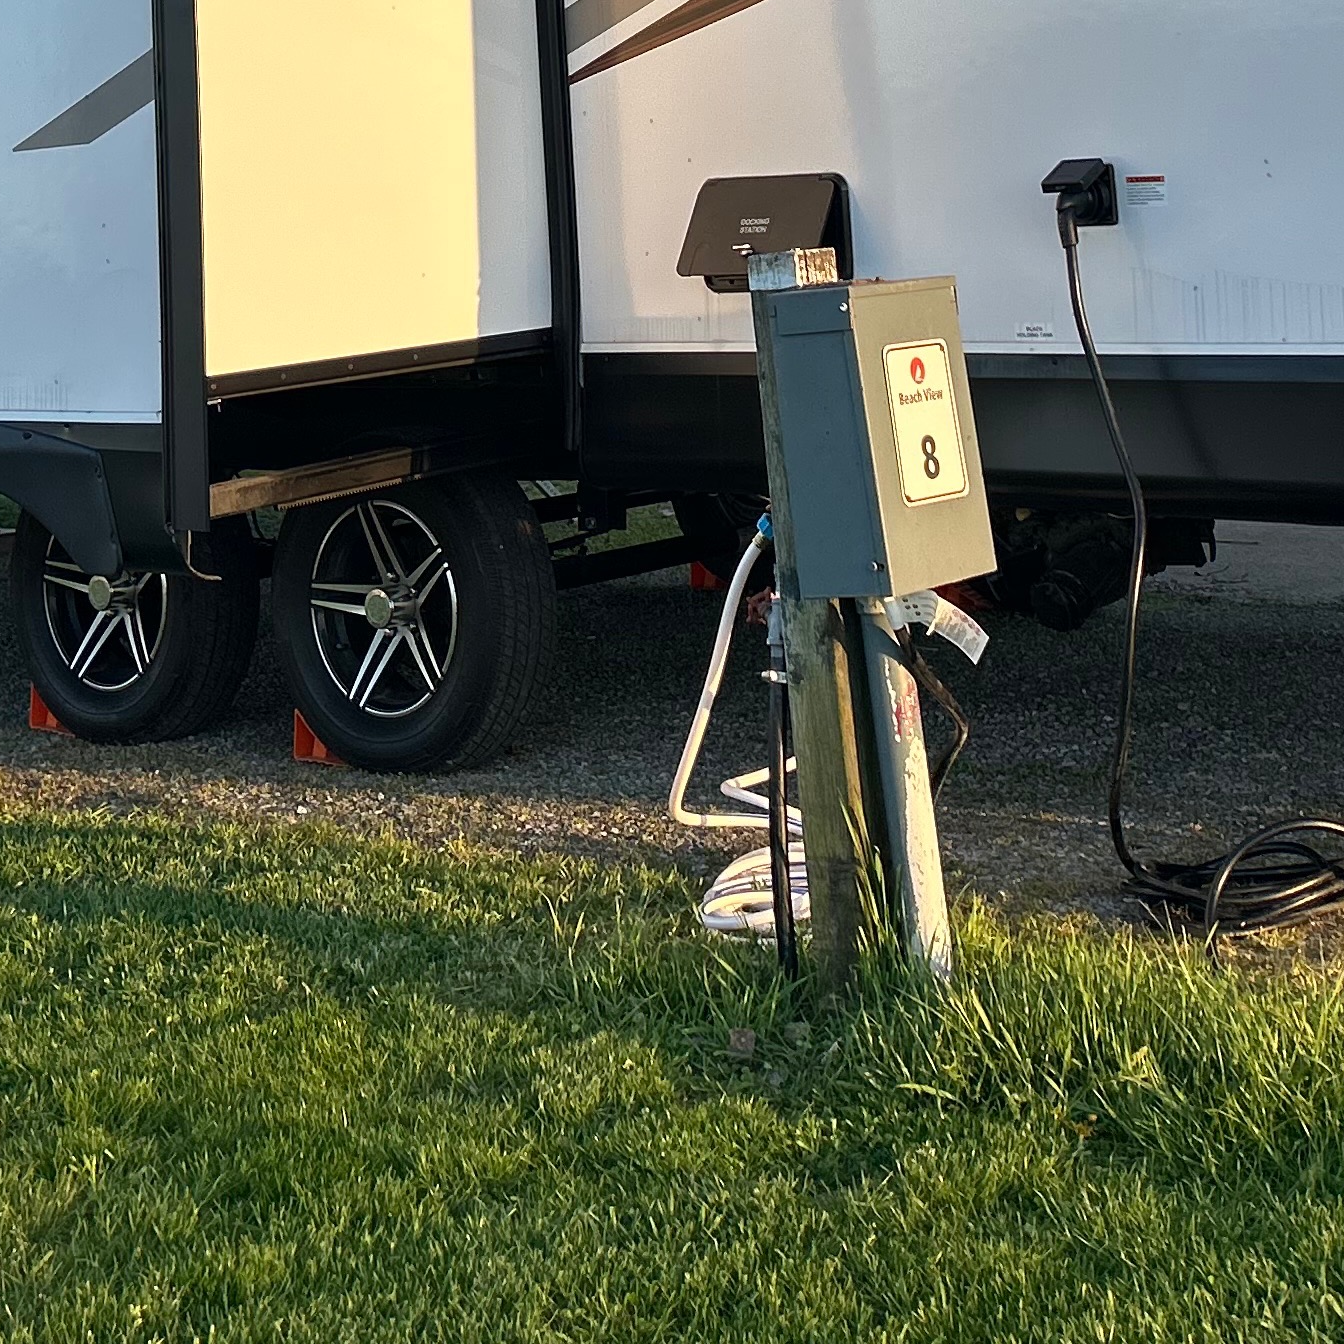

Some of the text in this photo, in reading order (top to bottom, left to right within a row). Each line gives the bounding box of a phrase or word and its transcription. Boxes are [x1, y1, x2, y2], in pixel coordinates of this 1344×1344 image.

[739, 225, 767, 234] STATION
[898, 387, 943, 405] Beach View
[921, 434, 940, 479] 8
